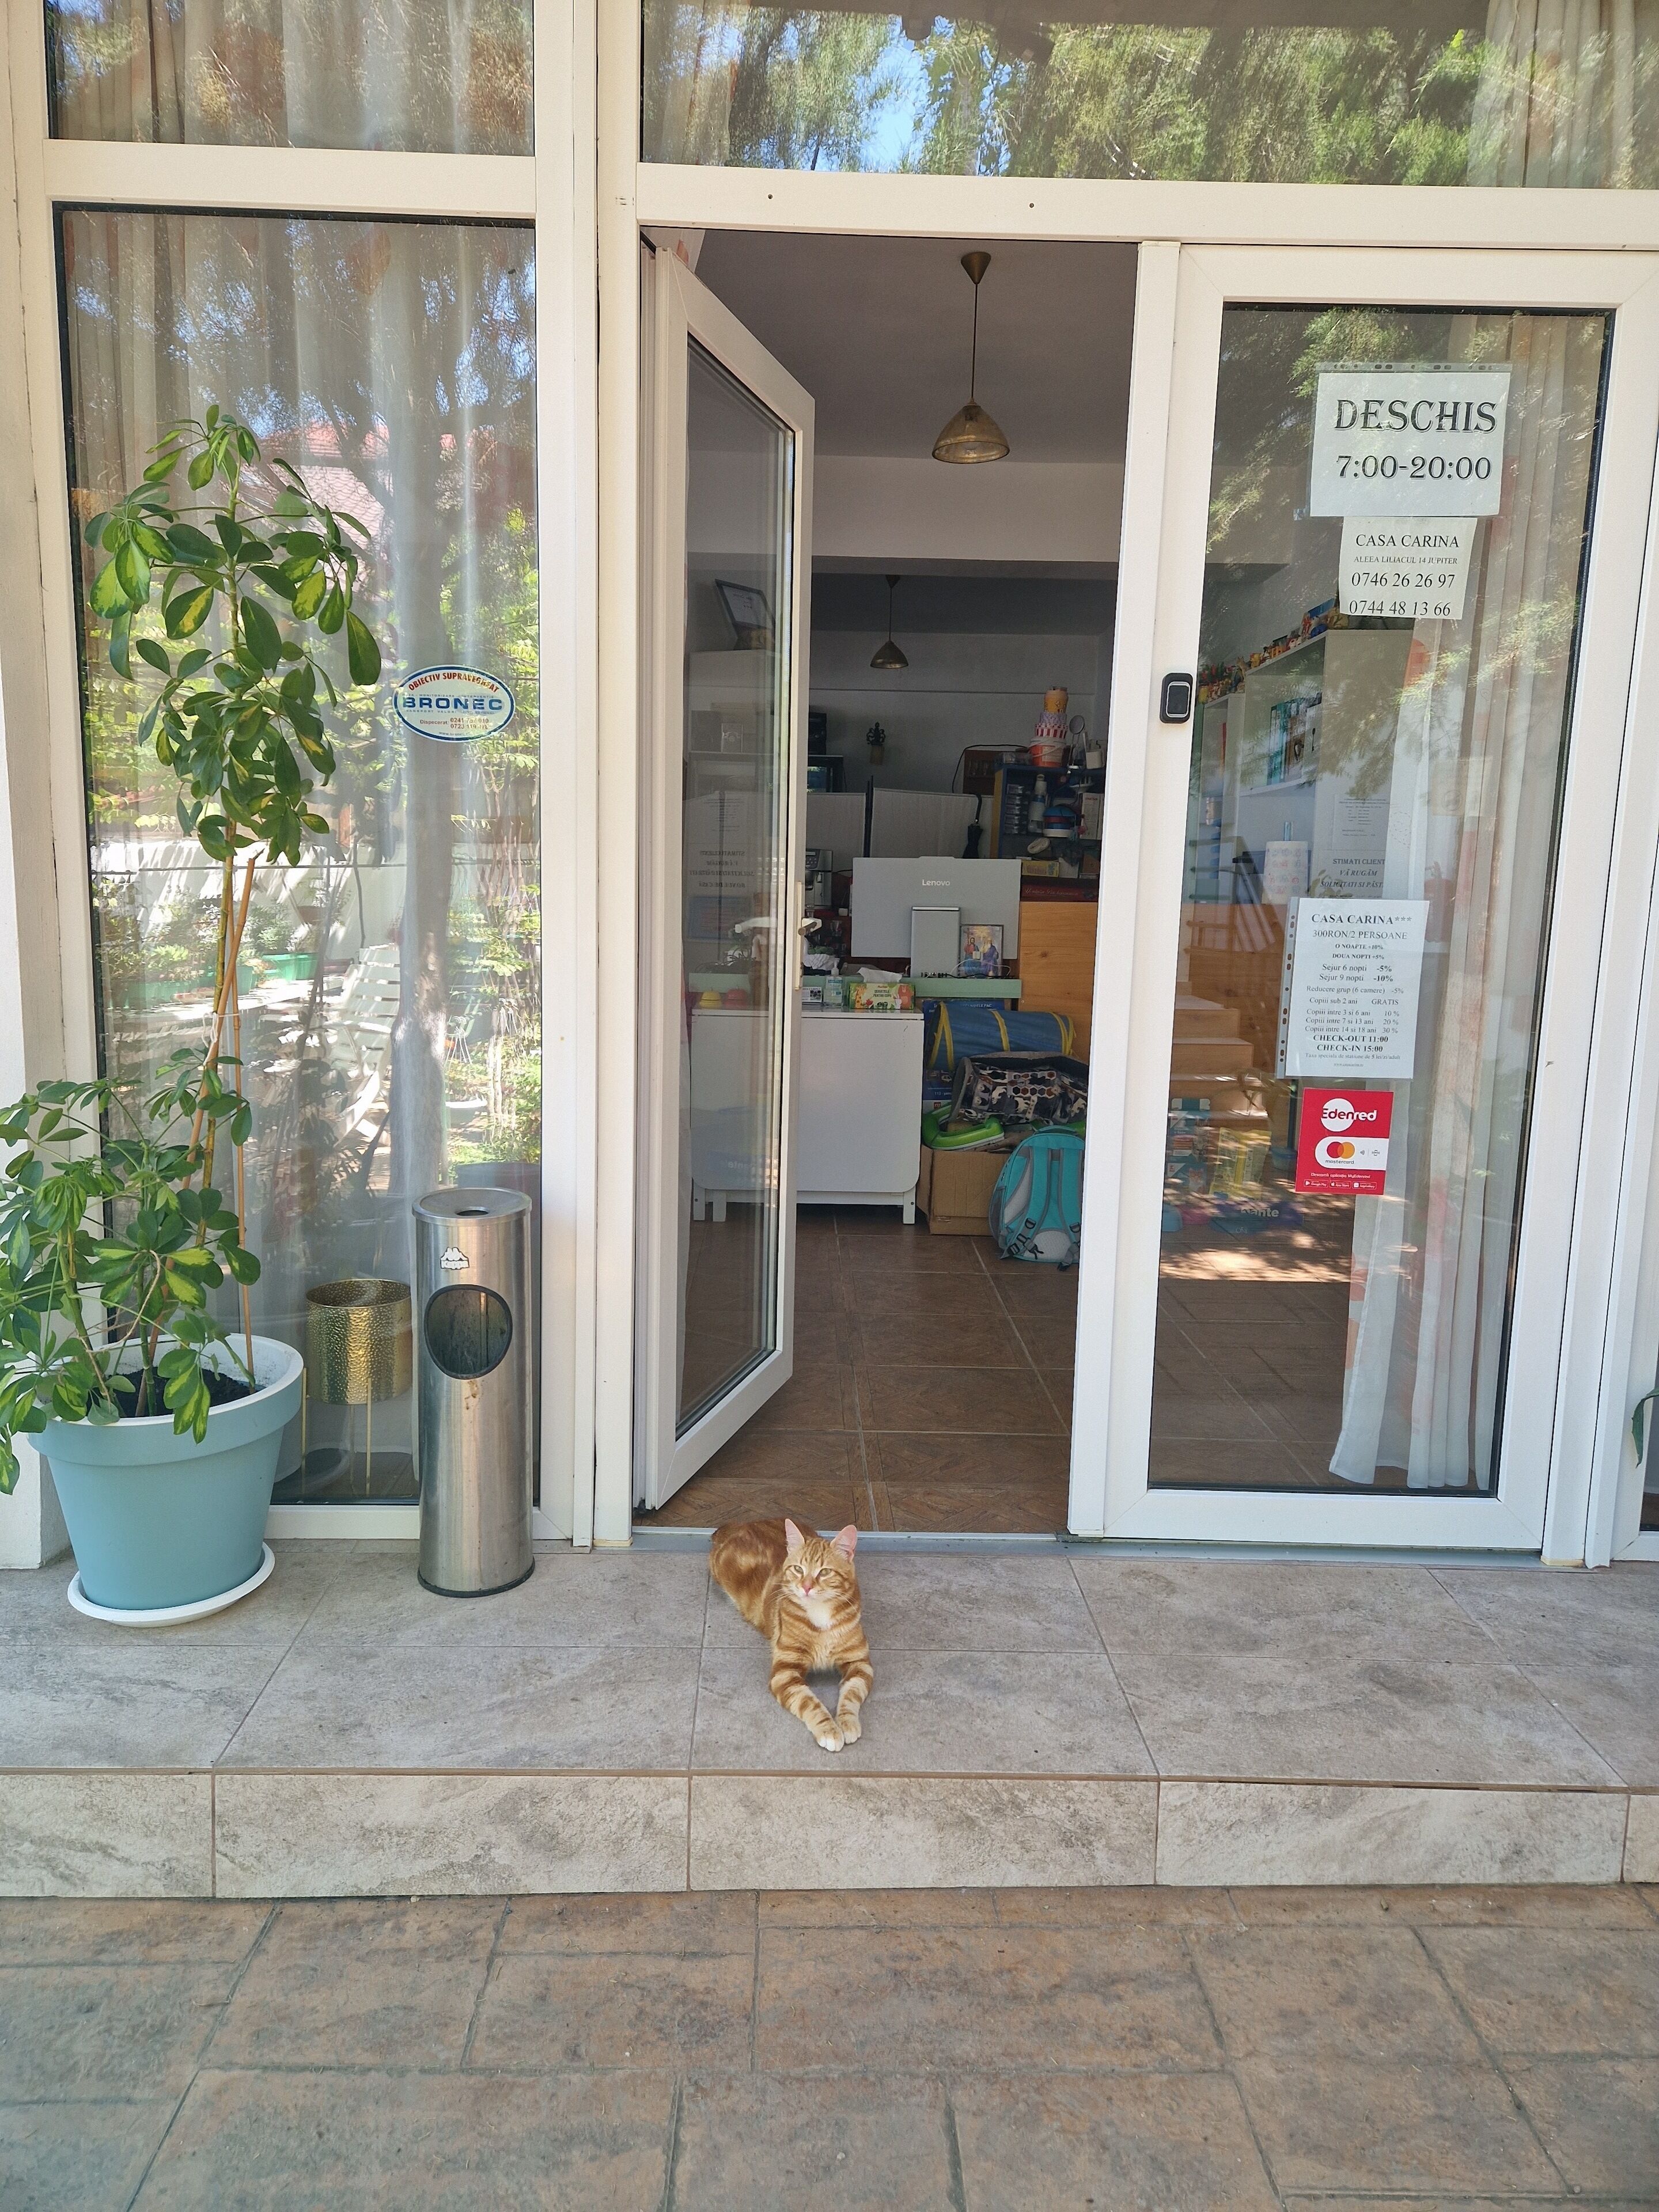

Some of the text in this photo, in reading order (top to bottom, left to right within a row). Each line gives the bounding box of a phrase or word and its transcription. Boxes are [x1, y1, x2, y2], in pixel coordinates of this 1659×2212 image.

[1334, 399, 1498, 433] DESCHIS
[1336, 455, 1492, 479] 7:00-20:00
[1356, 534, 1459, 547] CASA CARINA
[1351, 572, 1455, 588] 0746 26 26 97
[1349, 600, 1450, 616] 0744 48 13 66
[408, 673, 440, 691] OBIECTIV
[403, 697, 502, 710] BRONEC
[1312, 914, 1343, 923] CASA
[1358, 931, 1407, 939] PERSOANE
[1349, 964, 1367, 972] nopti
[1319, 974, 1338, 982] Sejur
[1346, 974, 1363, 982] nopti
[1322, 1108, 1377, 1121] Edenred
